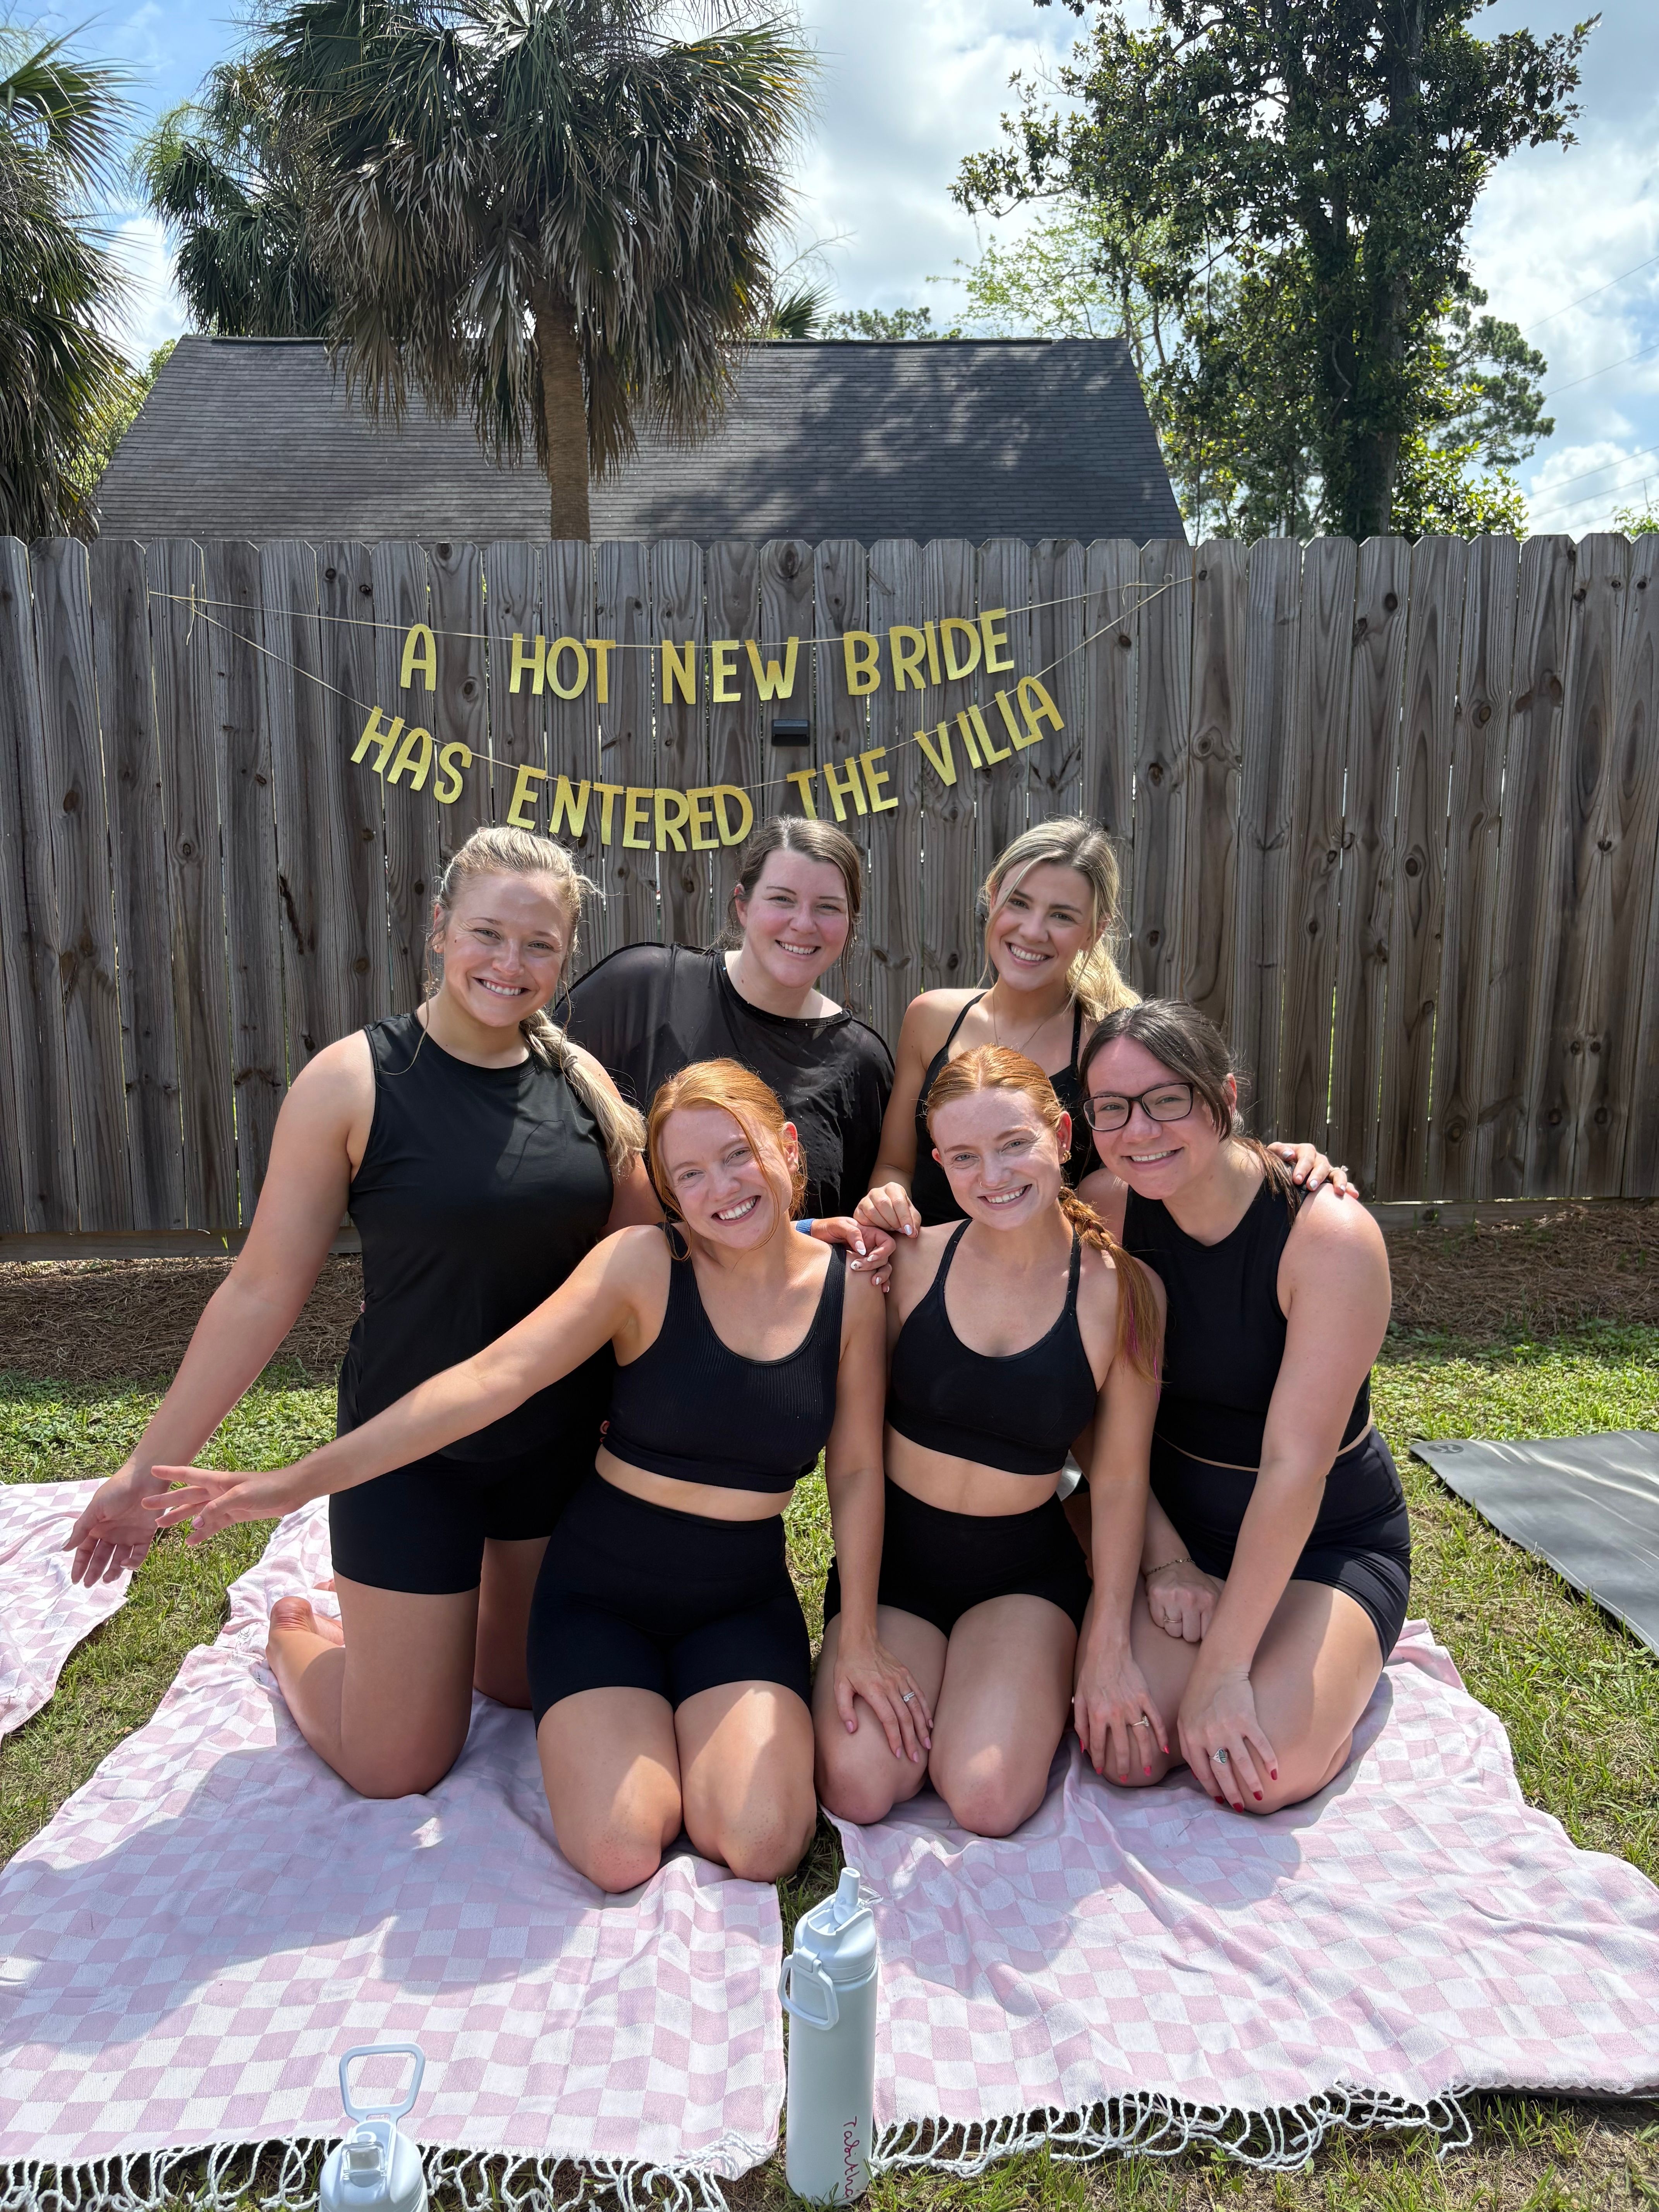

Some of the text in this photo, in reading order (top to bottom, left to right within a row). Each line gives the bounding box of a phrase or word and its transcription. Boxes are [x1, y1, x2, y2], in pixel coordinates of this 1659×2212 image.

[400, 608, 1015, 704] A HOT NEW BRIDE
[350, 676, 1065, 852] HAS ENTERED THE VILLA
[843, 2116, 860, 2198] Tabitha
